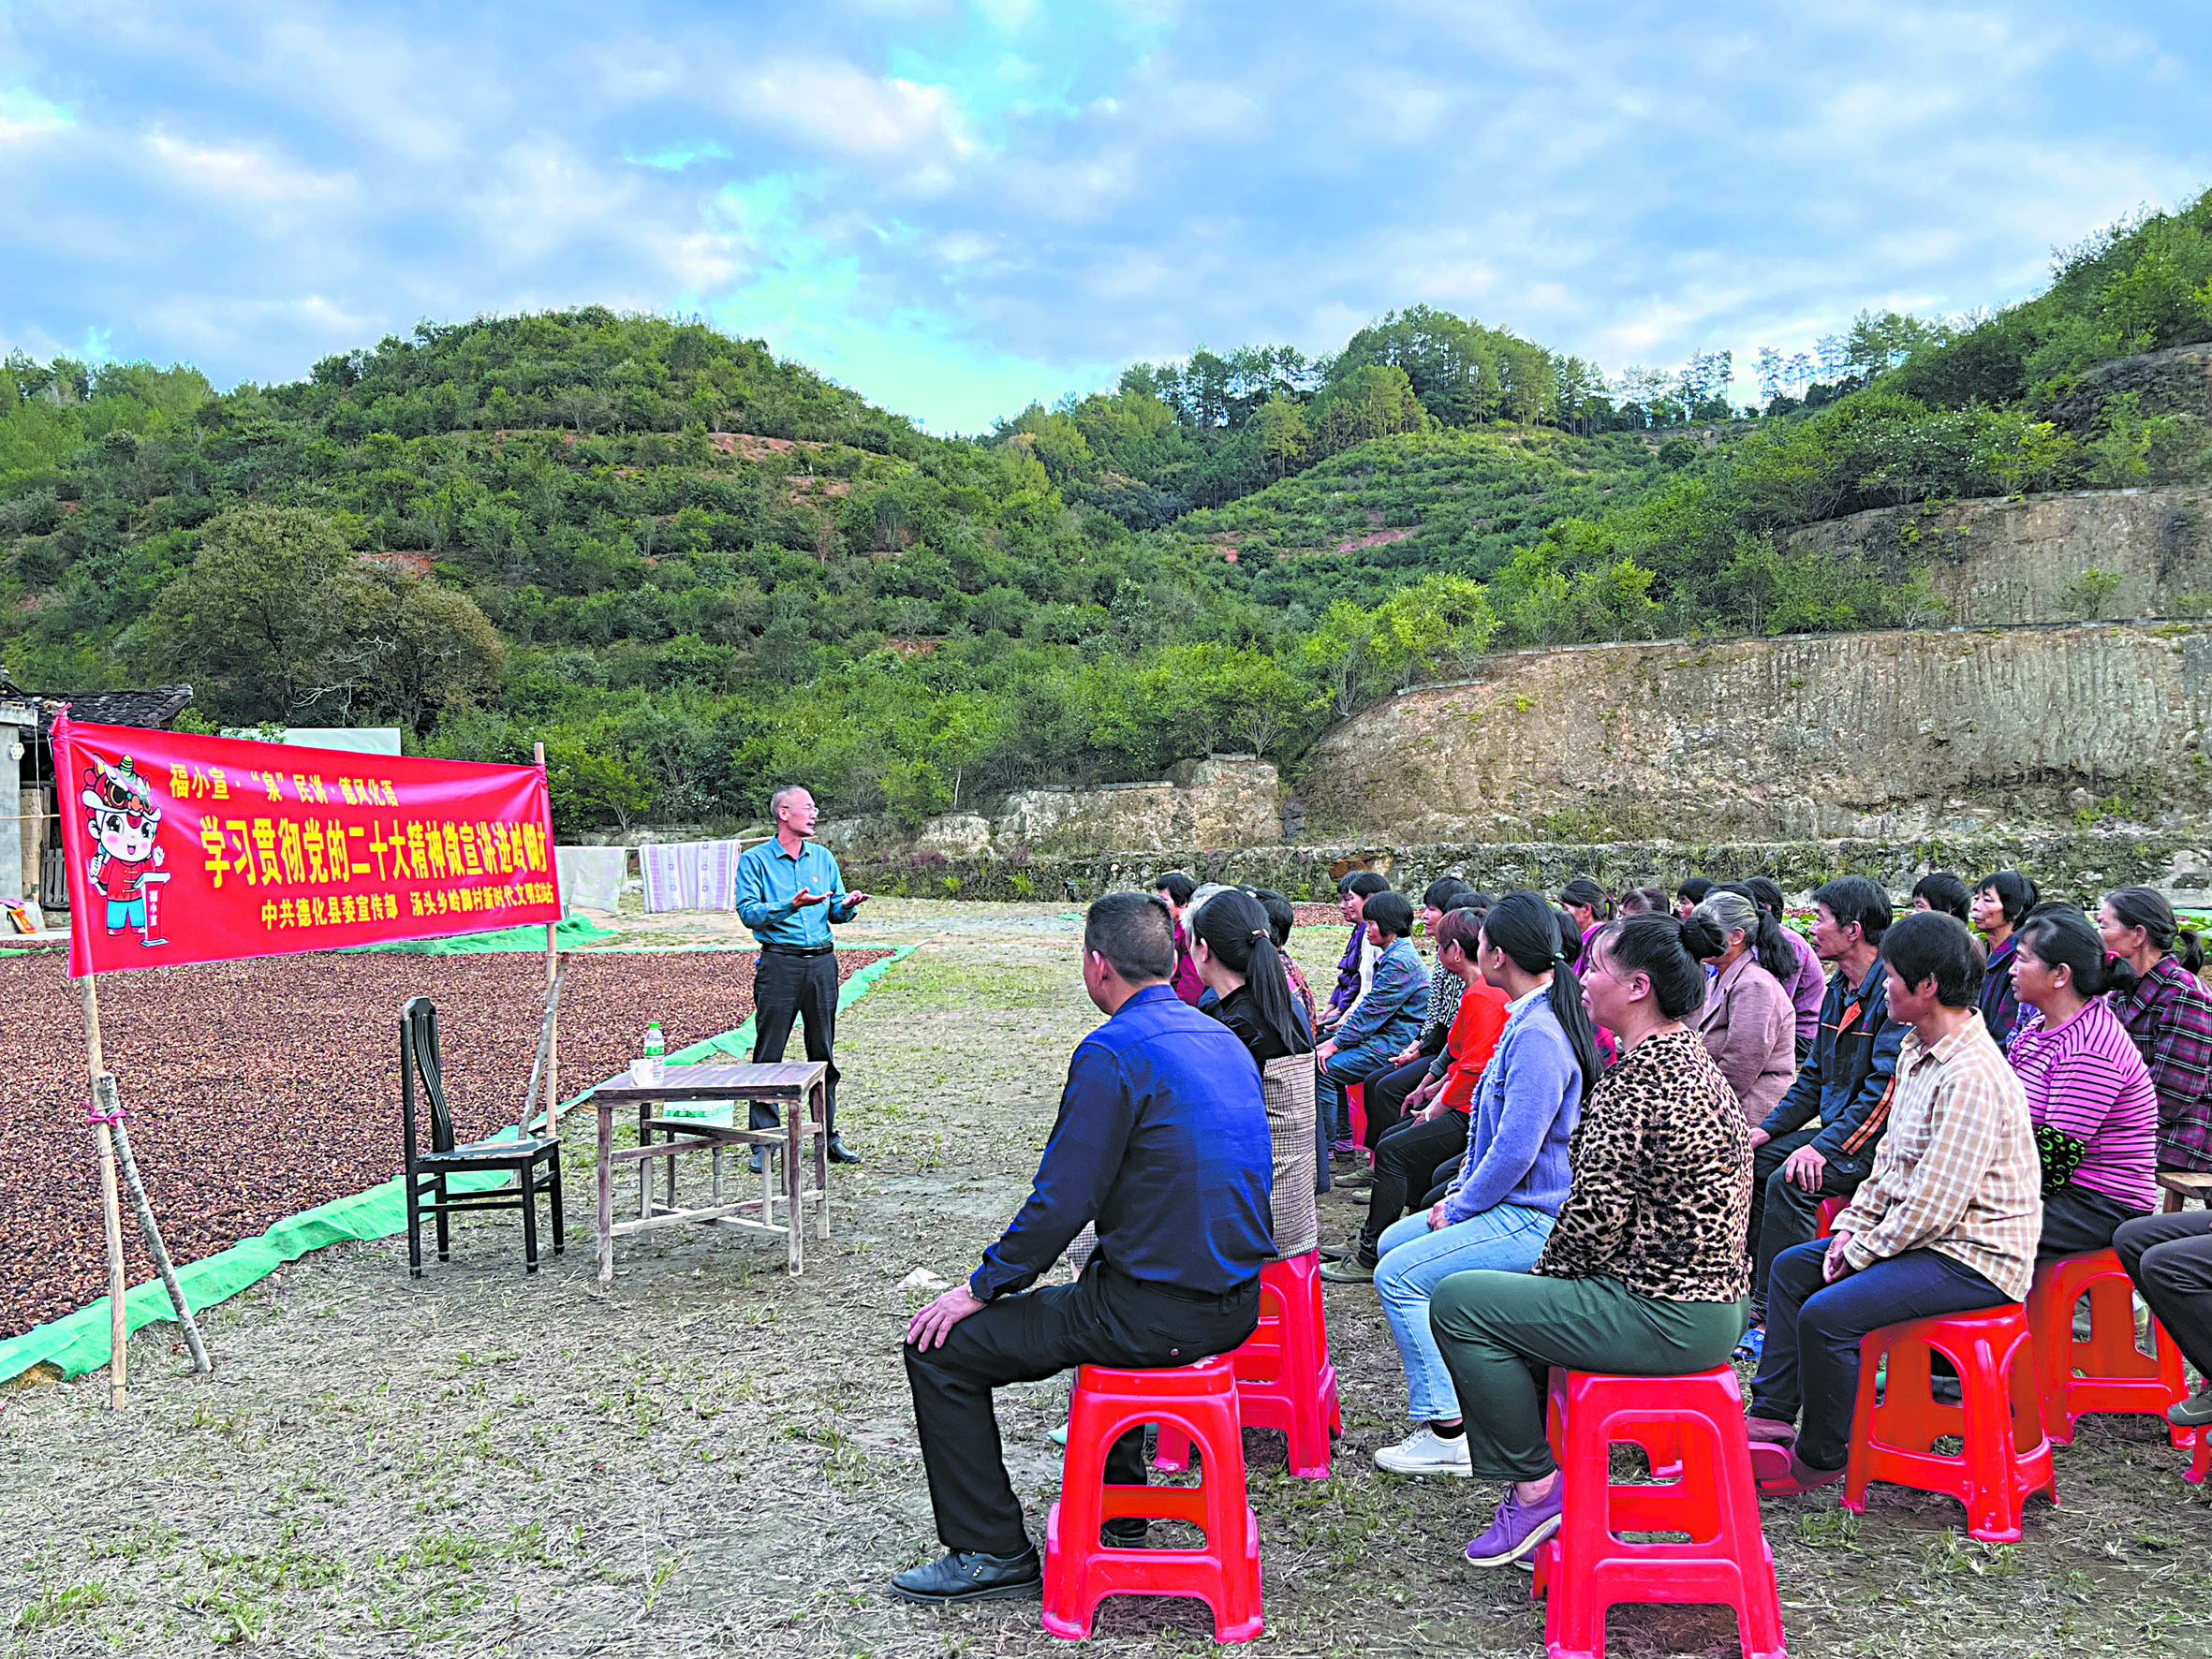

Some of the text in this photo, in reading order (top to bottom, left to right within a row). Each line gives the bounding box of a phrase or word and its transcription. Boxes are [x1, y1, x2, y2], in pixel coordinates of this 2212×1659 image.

[261, 892, 399, 931] 中共德化县委宣传部
